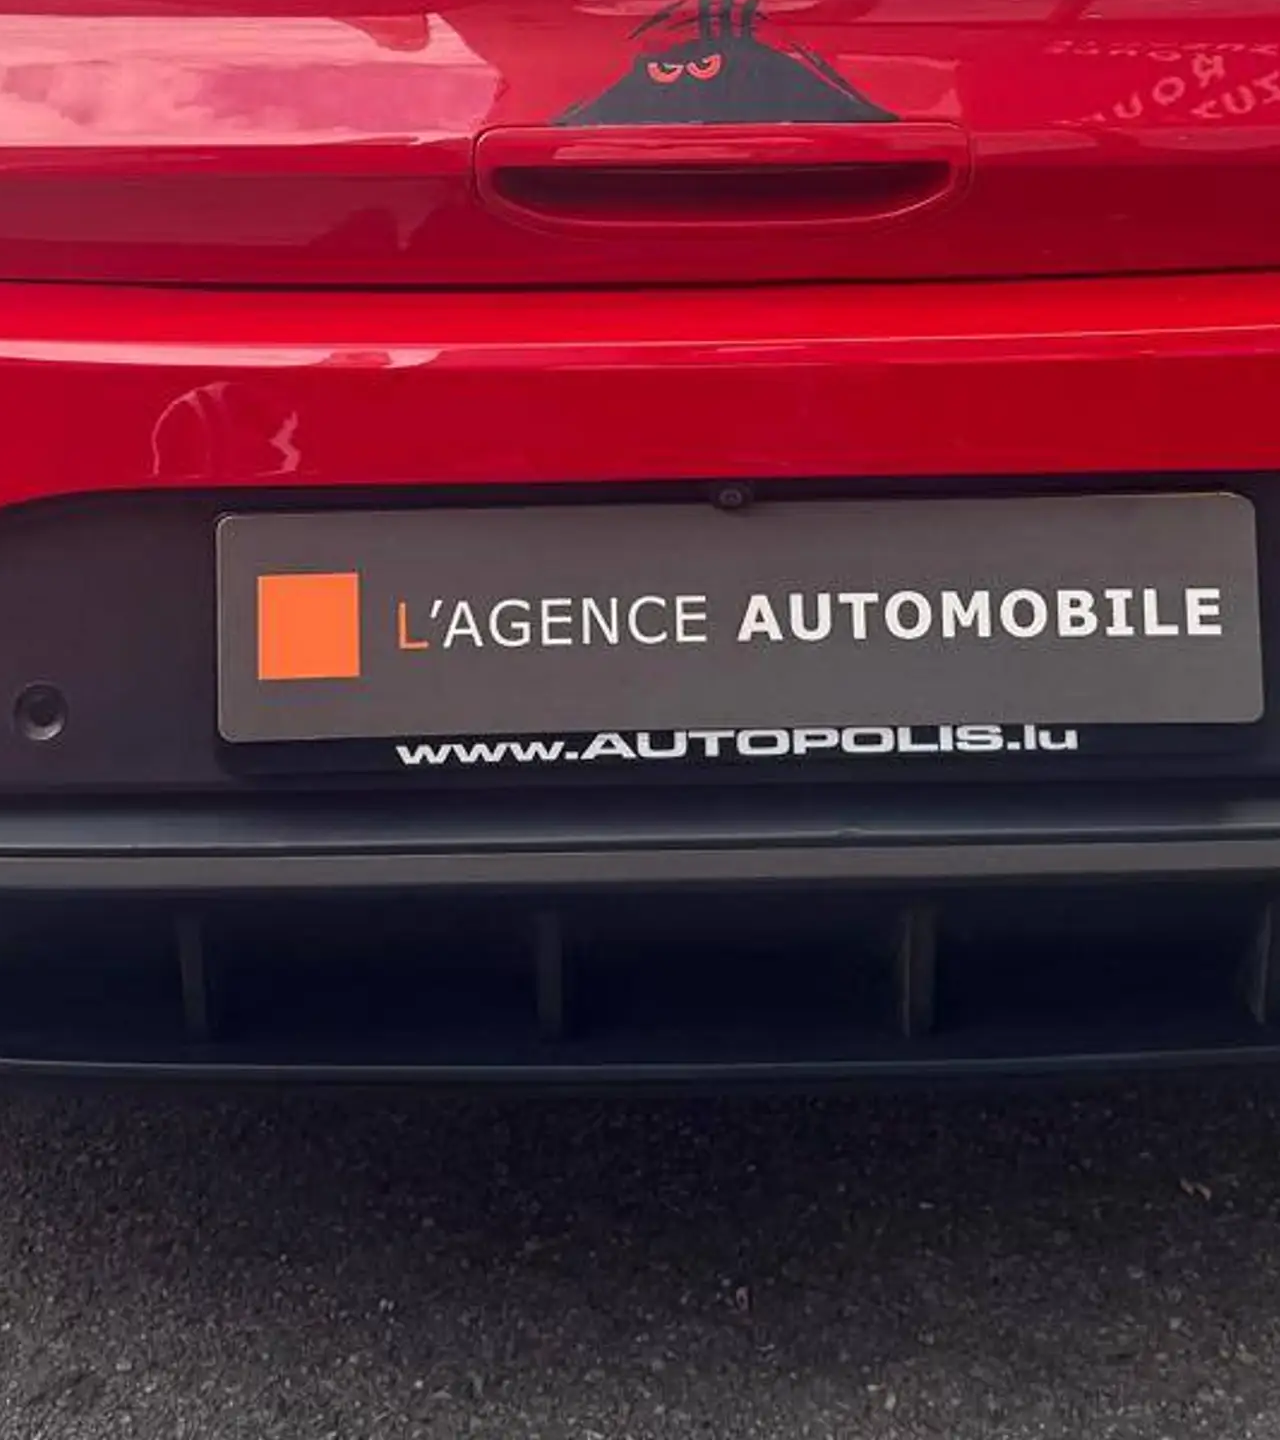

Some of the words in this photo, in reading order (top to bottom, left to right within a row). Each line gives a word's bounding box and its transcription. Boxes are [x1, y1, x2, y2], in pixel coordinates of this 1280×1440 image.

[397, 595, 708, 649] L'AGENCE
[737, 588, 1222, 642] AUTOMOBILE
[395, 724, 1078, 765] www.AUTOPOLIS.lu
